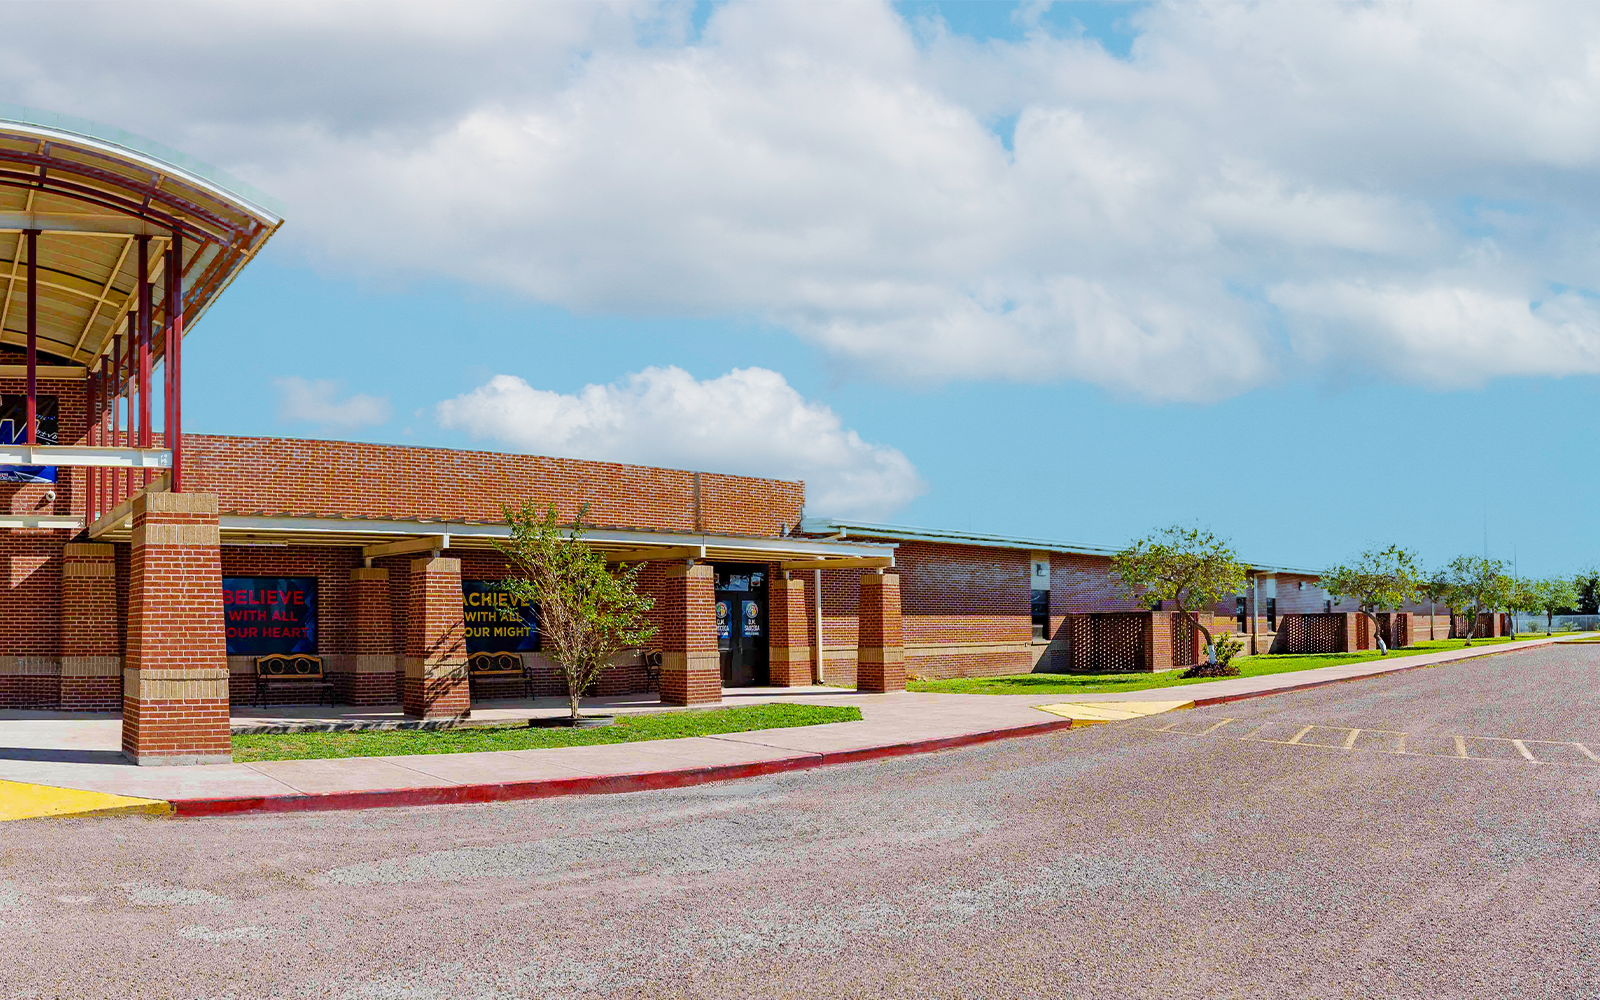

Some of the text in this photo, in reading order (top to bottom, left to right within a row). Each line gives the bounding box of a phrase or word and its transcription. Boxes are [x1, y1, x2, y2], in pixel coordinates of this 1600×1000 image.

[223, 590, 304, 605] BELIEVE
[228, 610, 298, 622] WITH ALL
[464, 611, 523, 622] WITH ALL
[226, 627, 310, 638] OUR HEART
[464, 627, 531, 637] OUR MIGHT
